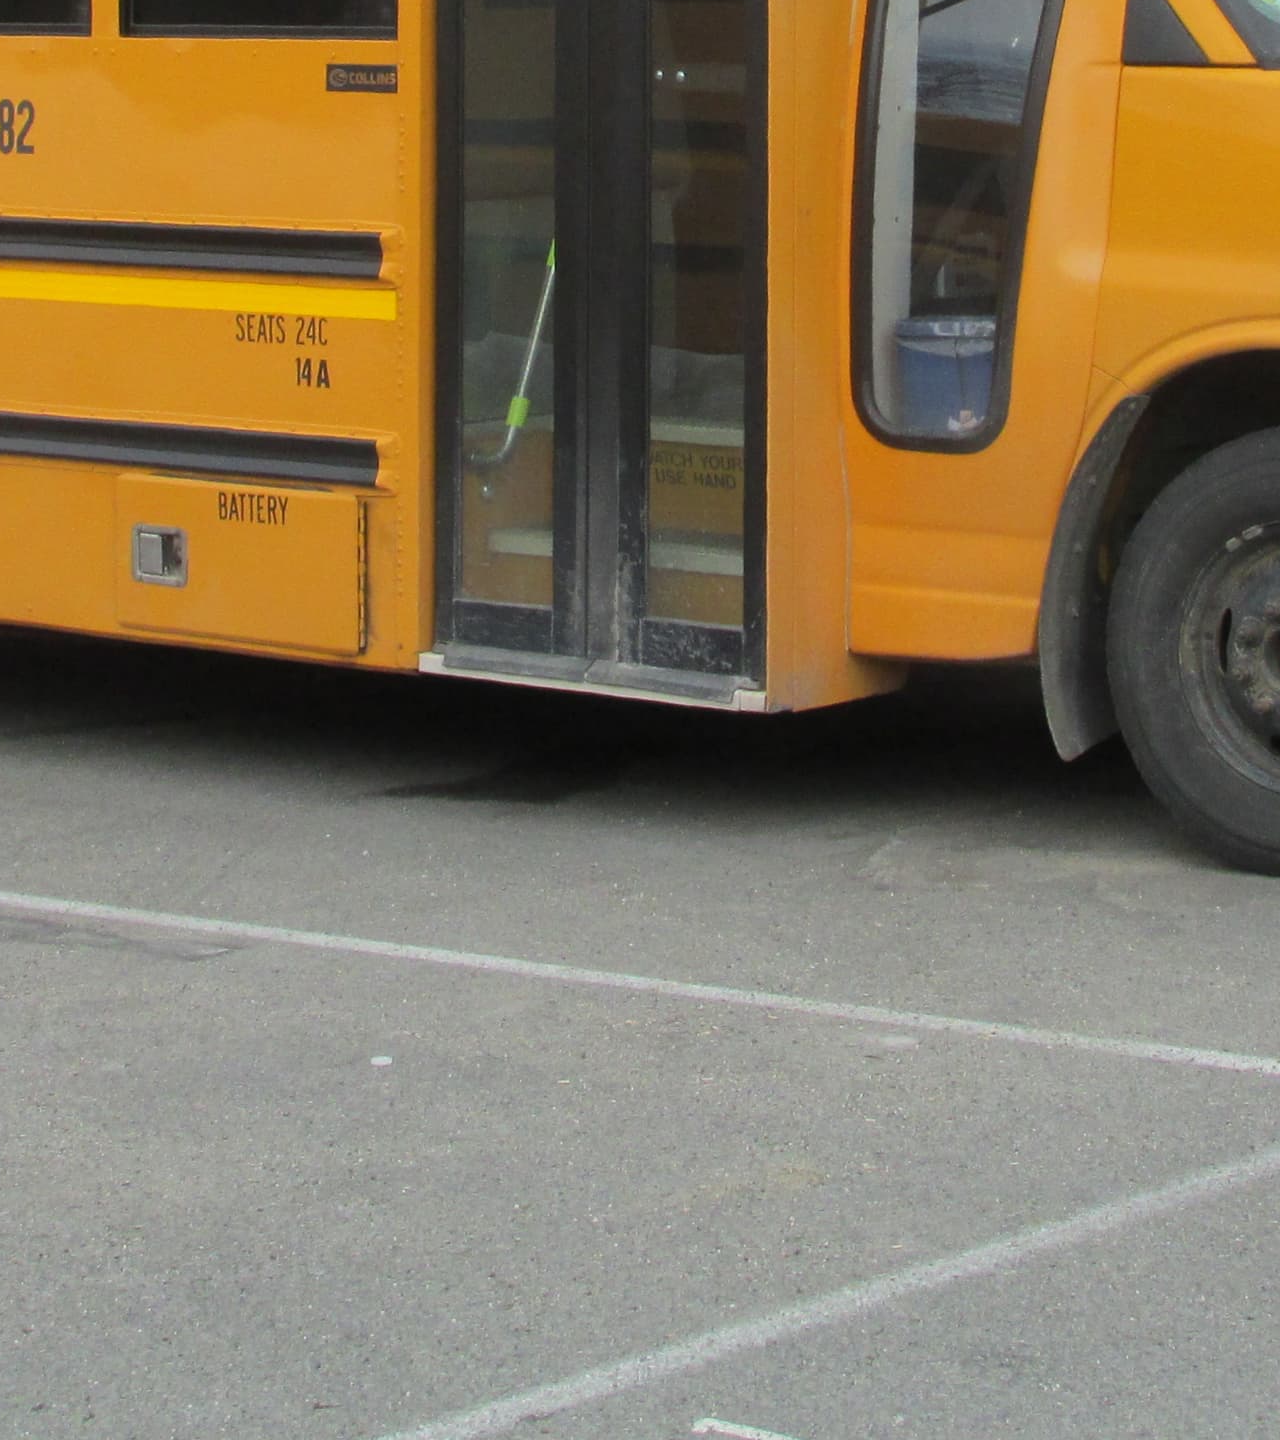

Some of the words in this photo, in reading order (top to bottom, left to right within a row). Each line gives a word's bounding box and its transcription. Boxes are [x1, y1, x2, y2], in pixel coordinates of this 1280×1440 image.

[348, 71, 396, 86] COLLINS
[235, 313, 286, 344] SEATS
[295, 316, 328, 346] 24C
[649, 448, 694, 469] ATCH
[694, 471, 737, 490] HAND
[218, 491, 289, 526] BATTERY
